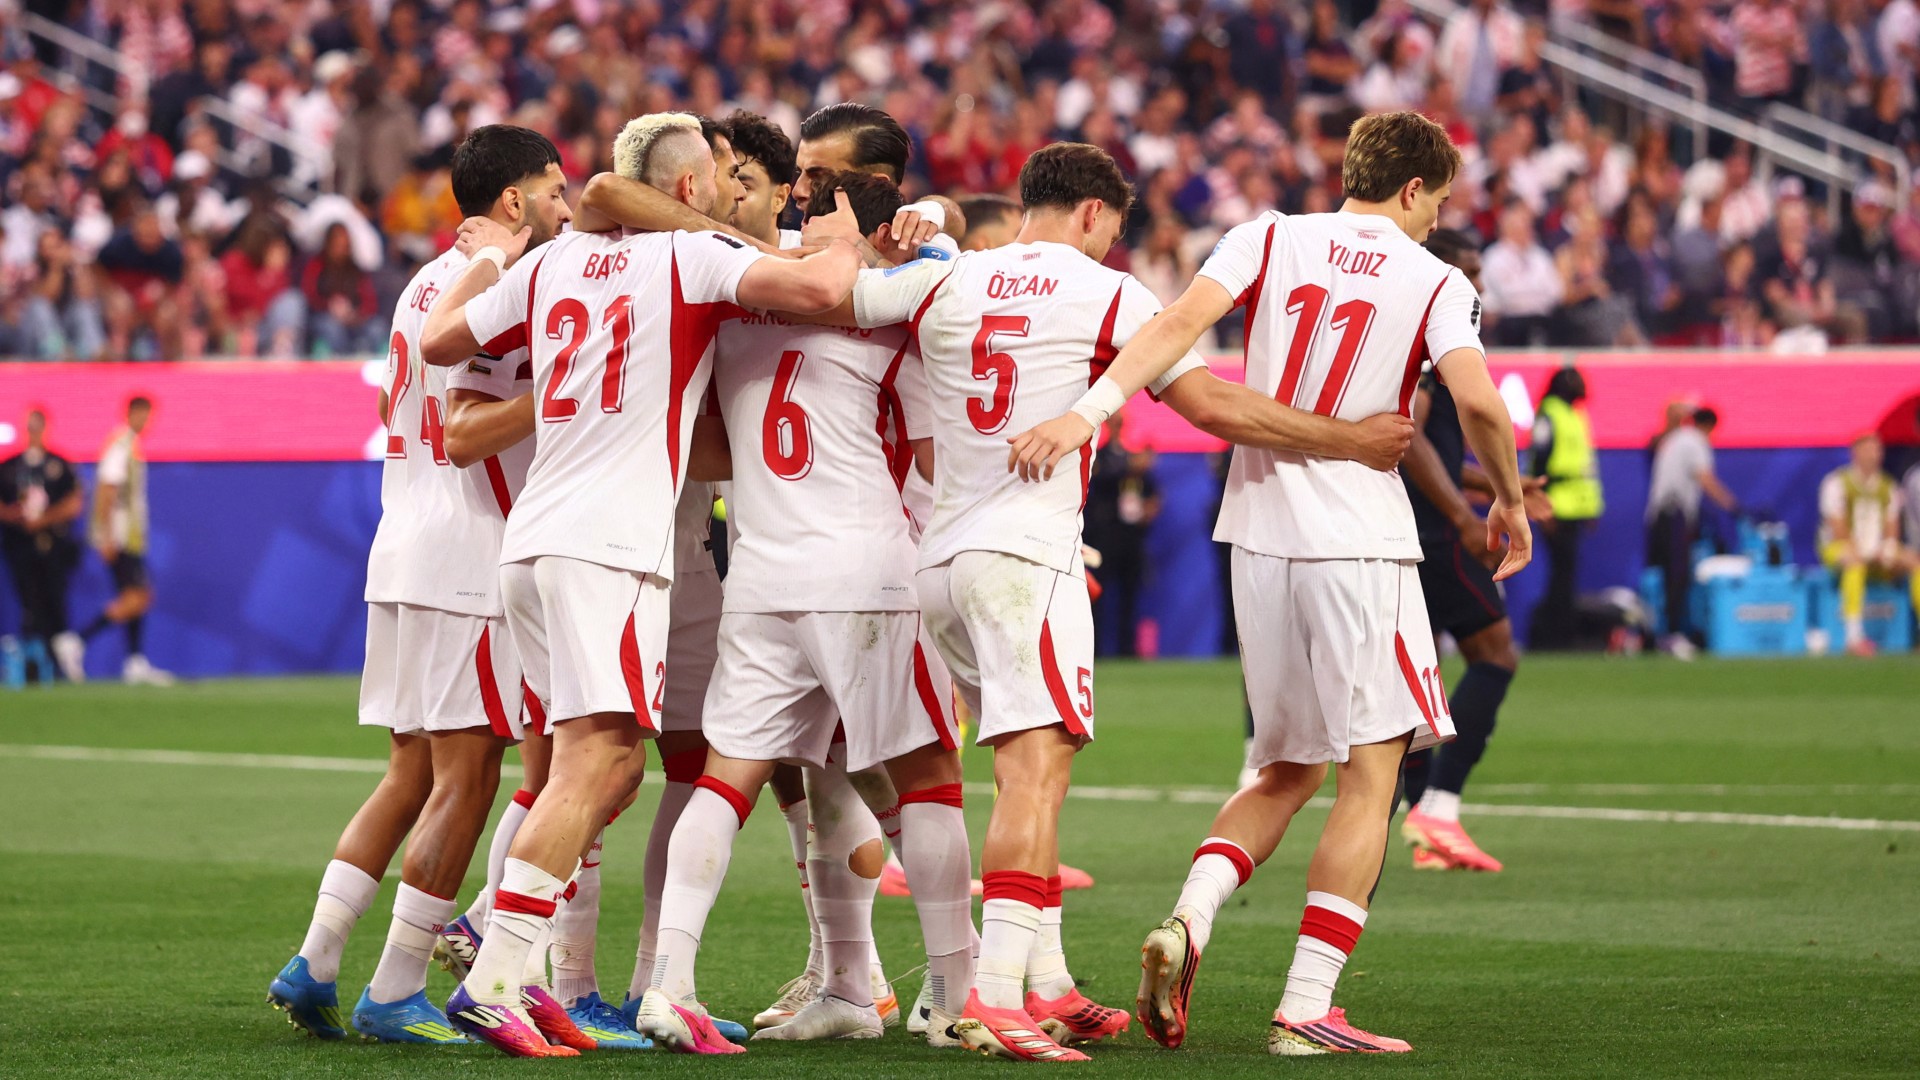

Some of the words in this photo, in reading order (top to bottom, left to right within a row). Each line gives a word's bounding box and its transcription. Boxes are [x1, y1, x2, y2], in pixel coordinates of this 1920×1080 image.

[582, 248, 631, 281] BAIŞ
[986, 269, 1060, 301] ÖZCAN
[1327, 239, 1388, 277] YILDIZ
[541, 294, 635, 424] 21
[966, 315, 1030, 436] 5
[1275, 283, 1377, 419] 11
[385, 330, 451, 466] 24
[762, 350, 815, 482] 6
[1077, 666, 1093, 720] 5
[1422, 665, 1451, 720] 11
